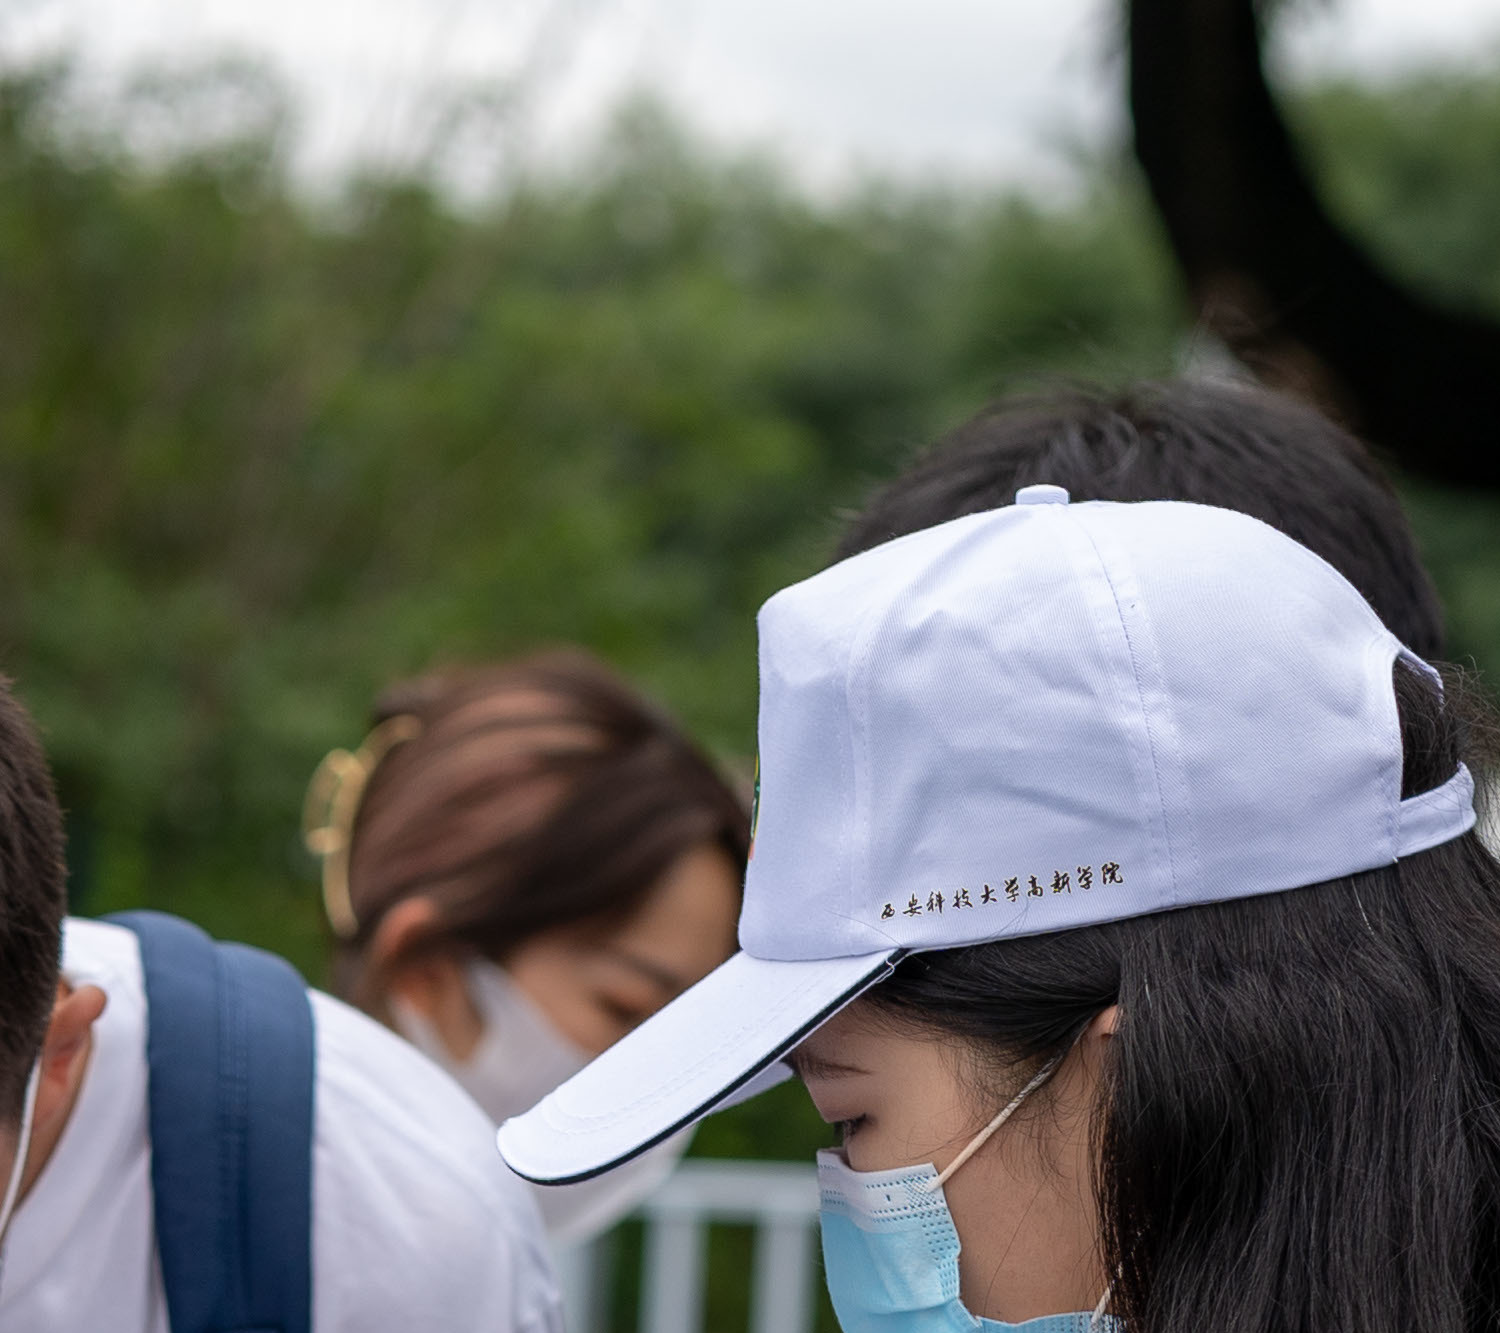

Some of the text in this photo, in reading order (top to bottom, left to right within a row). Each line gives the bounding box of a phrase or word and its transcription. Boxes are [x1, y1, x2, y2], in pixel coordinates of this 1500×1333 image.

[880, 861, 1124, 920] 西安科技大学高新学院
